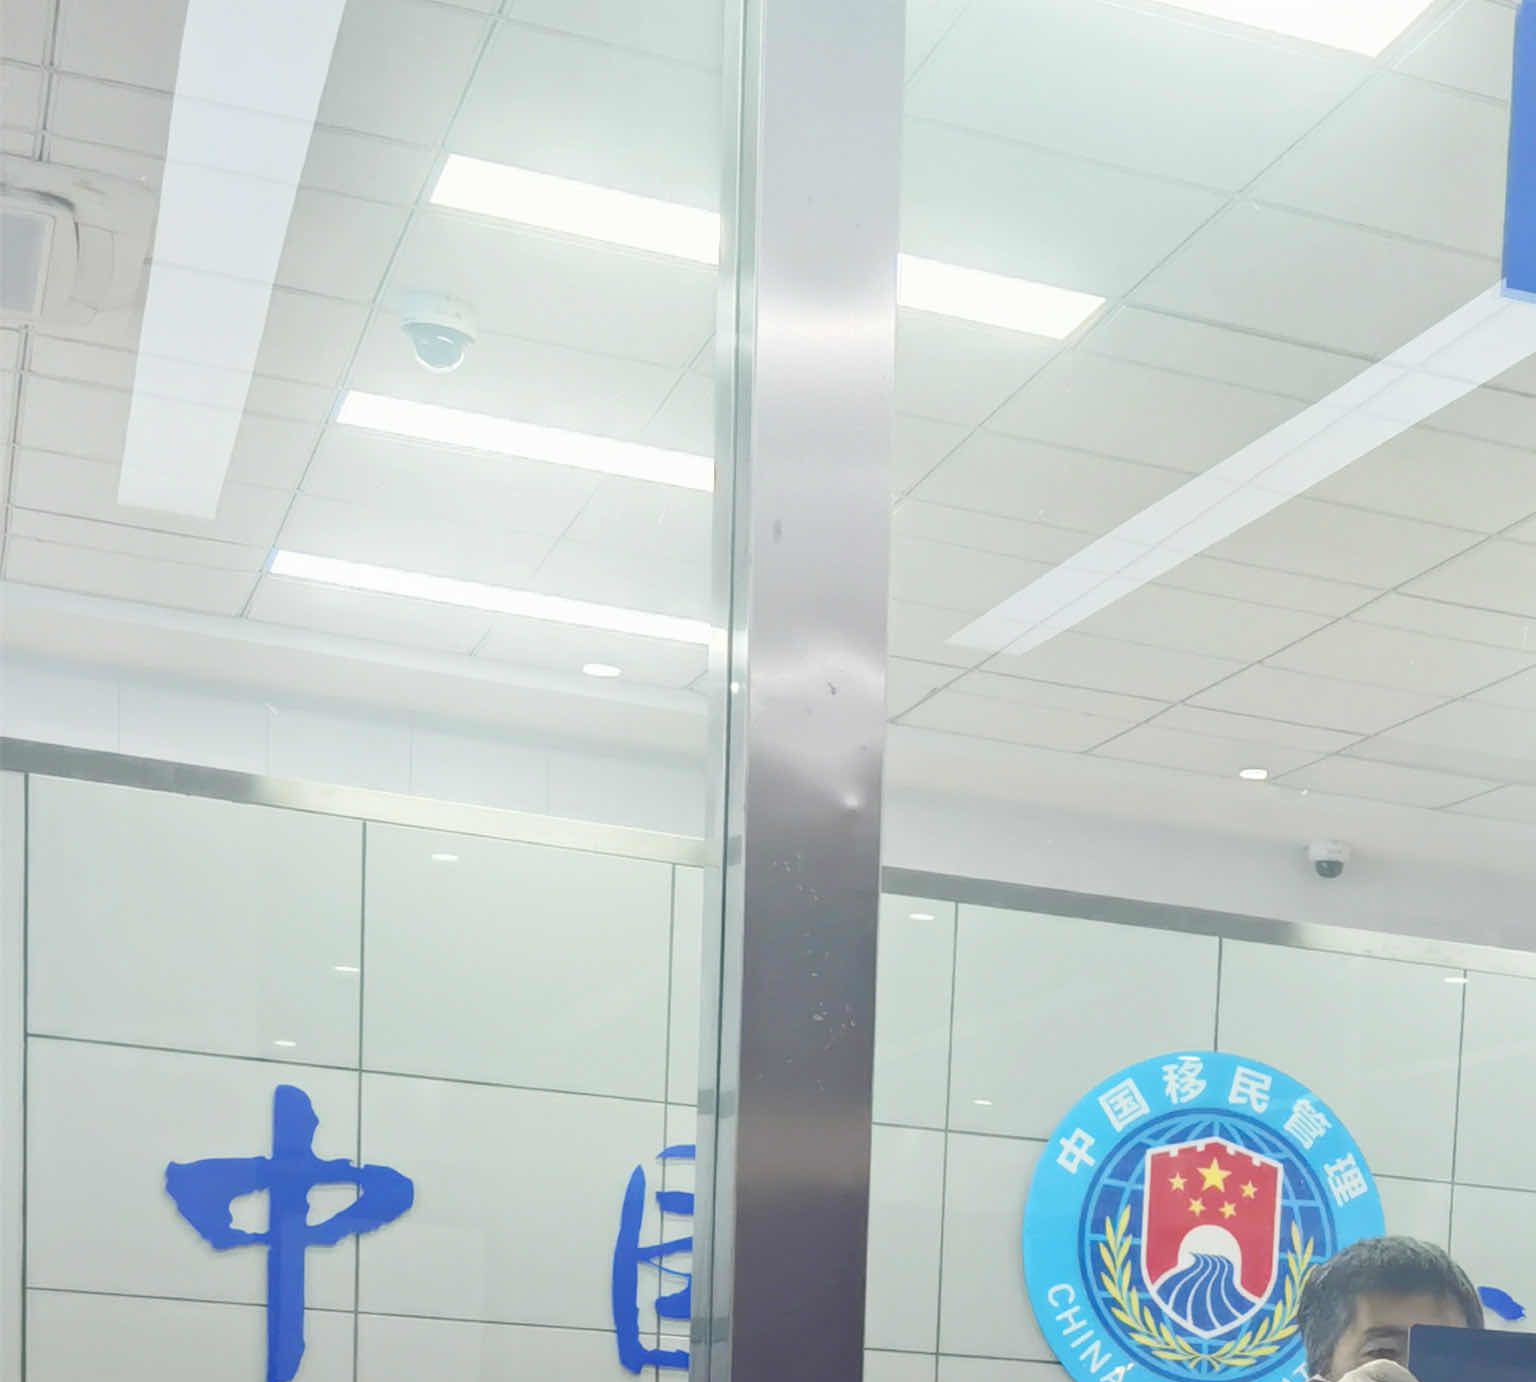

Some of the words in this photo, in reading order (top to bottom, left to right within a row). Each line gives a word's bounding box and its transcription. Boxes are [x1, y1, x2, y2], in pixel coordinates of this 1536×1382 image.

[1055, 1057, 1369, 1207] 中国移民管理
